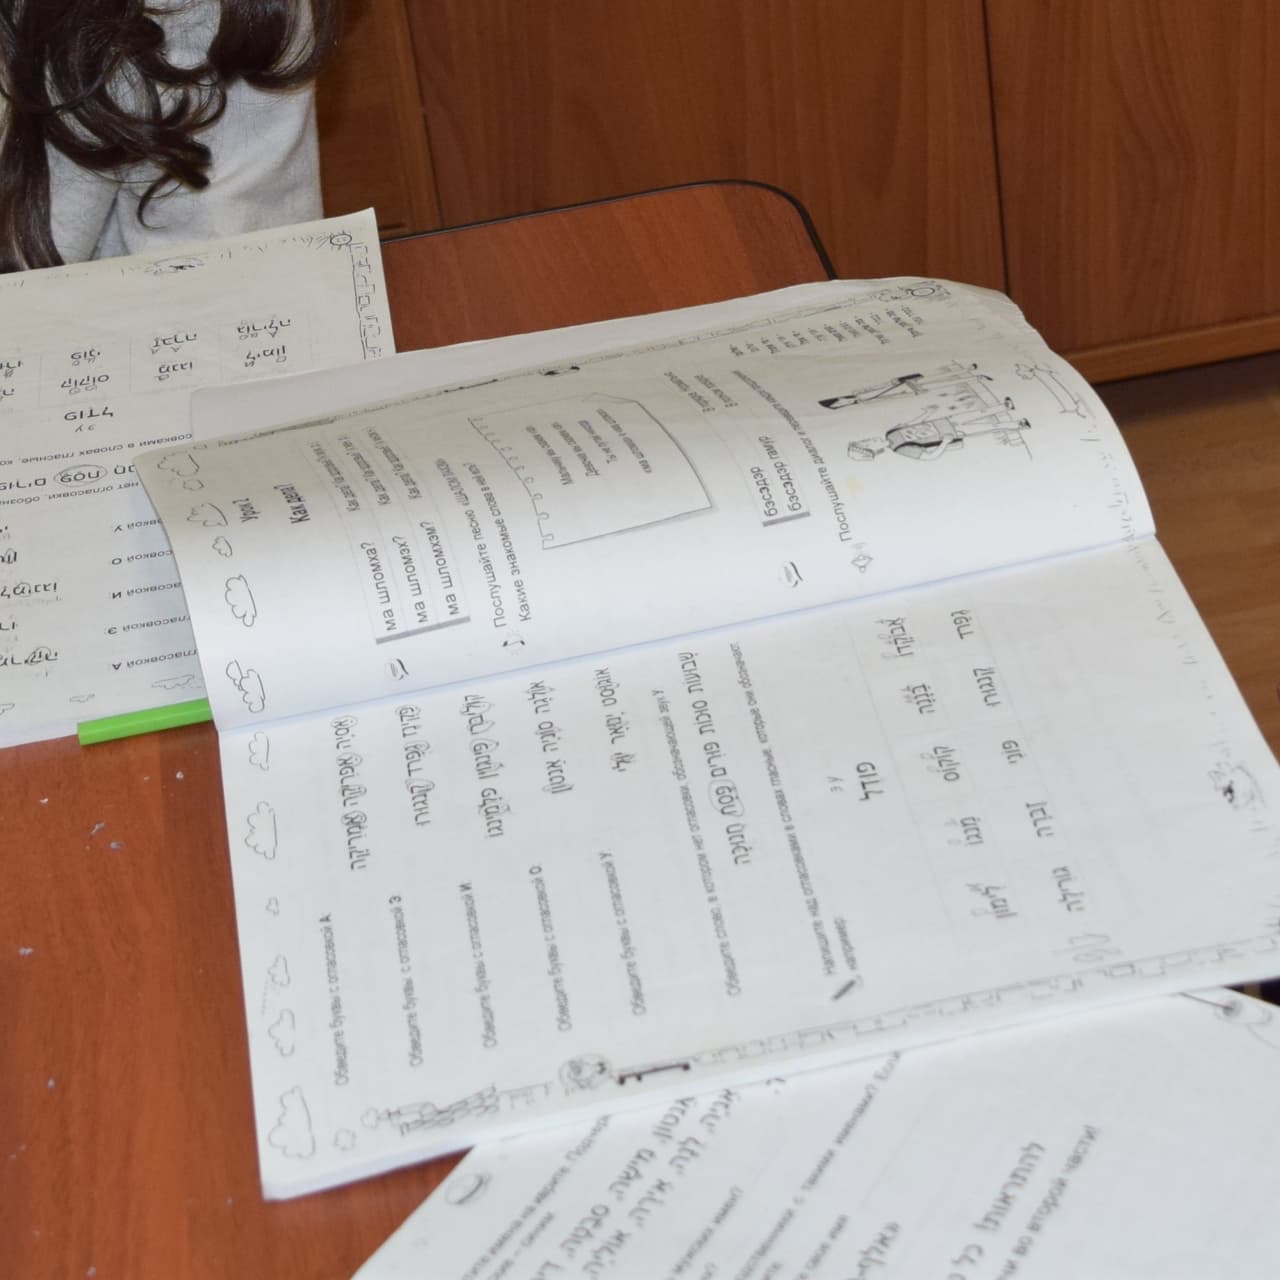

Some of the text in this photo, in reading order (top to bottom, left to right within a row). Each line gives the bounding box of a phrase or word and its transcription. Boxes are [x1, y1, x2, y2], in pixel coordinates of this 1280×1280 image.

[271, 482, 312, 525] Как дела?
[482, 490, 502, 517] слова
[748, 465, 779, 517] бэсэдэр
[756, 434, 803, 512] бэсэдэр гамур
[798, 436, 853, 543] Послушайте диалог
[237, 501, 261, 524] Урок
[492, 517, 521, 576] знакомые
[358, 540, 397, 632] ма шломха?
[390, 534, 429, 624] ма шломэх?
[418, 519, 460, 616] ма шломхэм?
[463, 507, 508, 629] Послушайте песню
[512, 577, 533, 623] Какие
